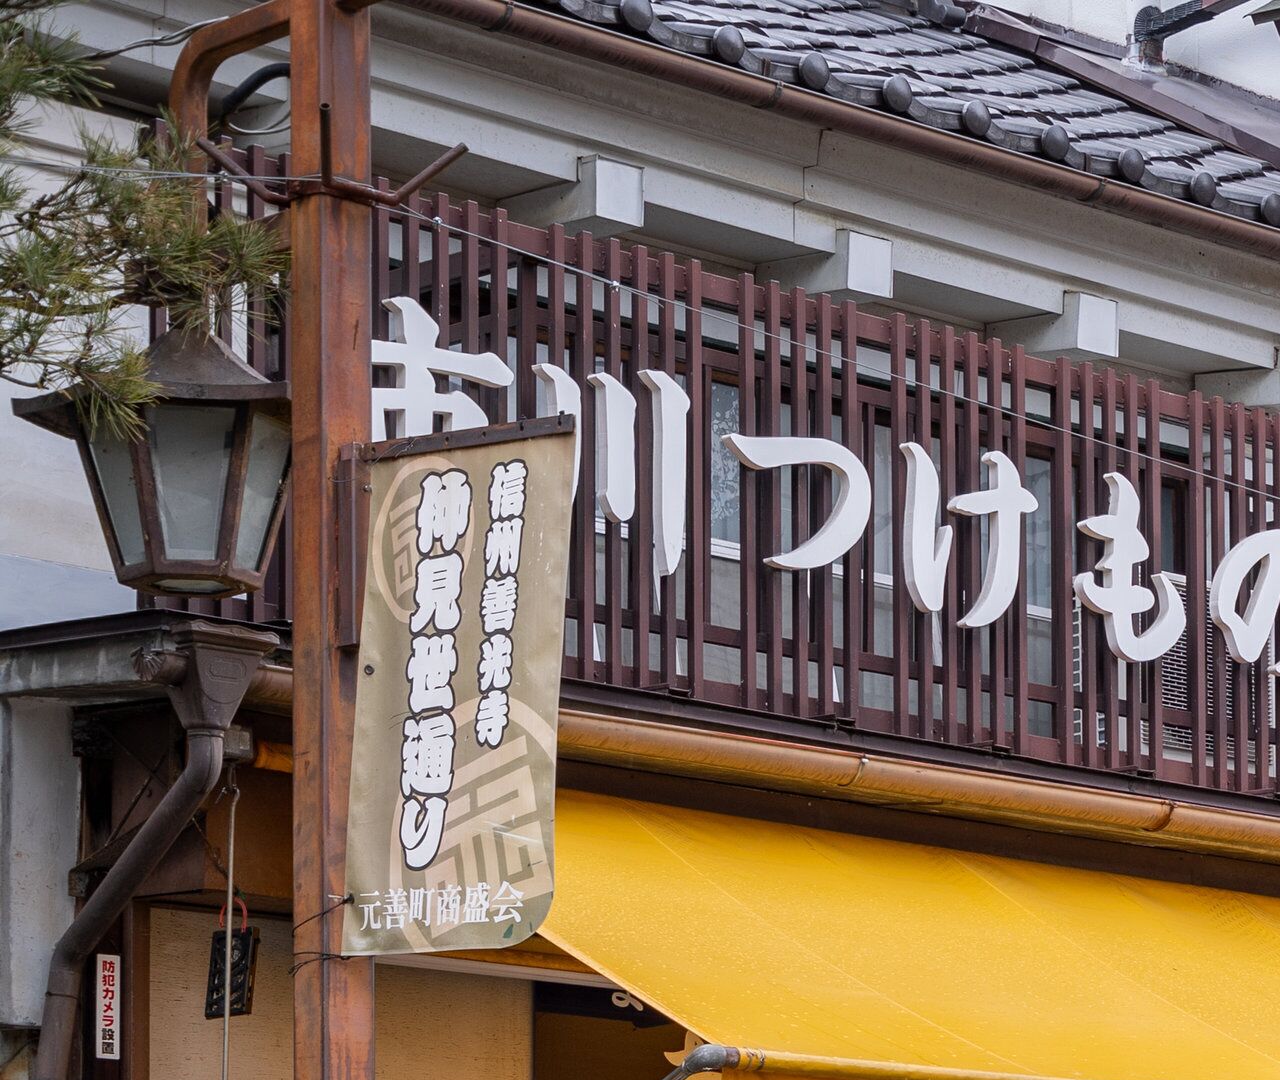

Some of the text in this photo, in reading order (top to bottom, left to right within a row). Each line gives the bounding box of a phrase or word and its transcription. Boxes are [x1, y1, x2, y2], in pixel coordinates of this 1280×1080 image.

[400, 467, 472, 870] 仲見世通り
[476, 459, 527, 749] 信州善光寺
[358, 880, 525, 932] 元善町商盛会
[101, 959, 116, 1056] 防犯カメラ設置
